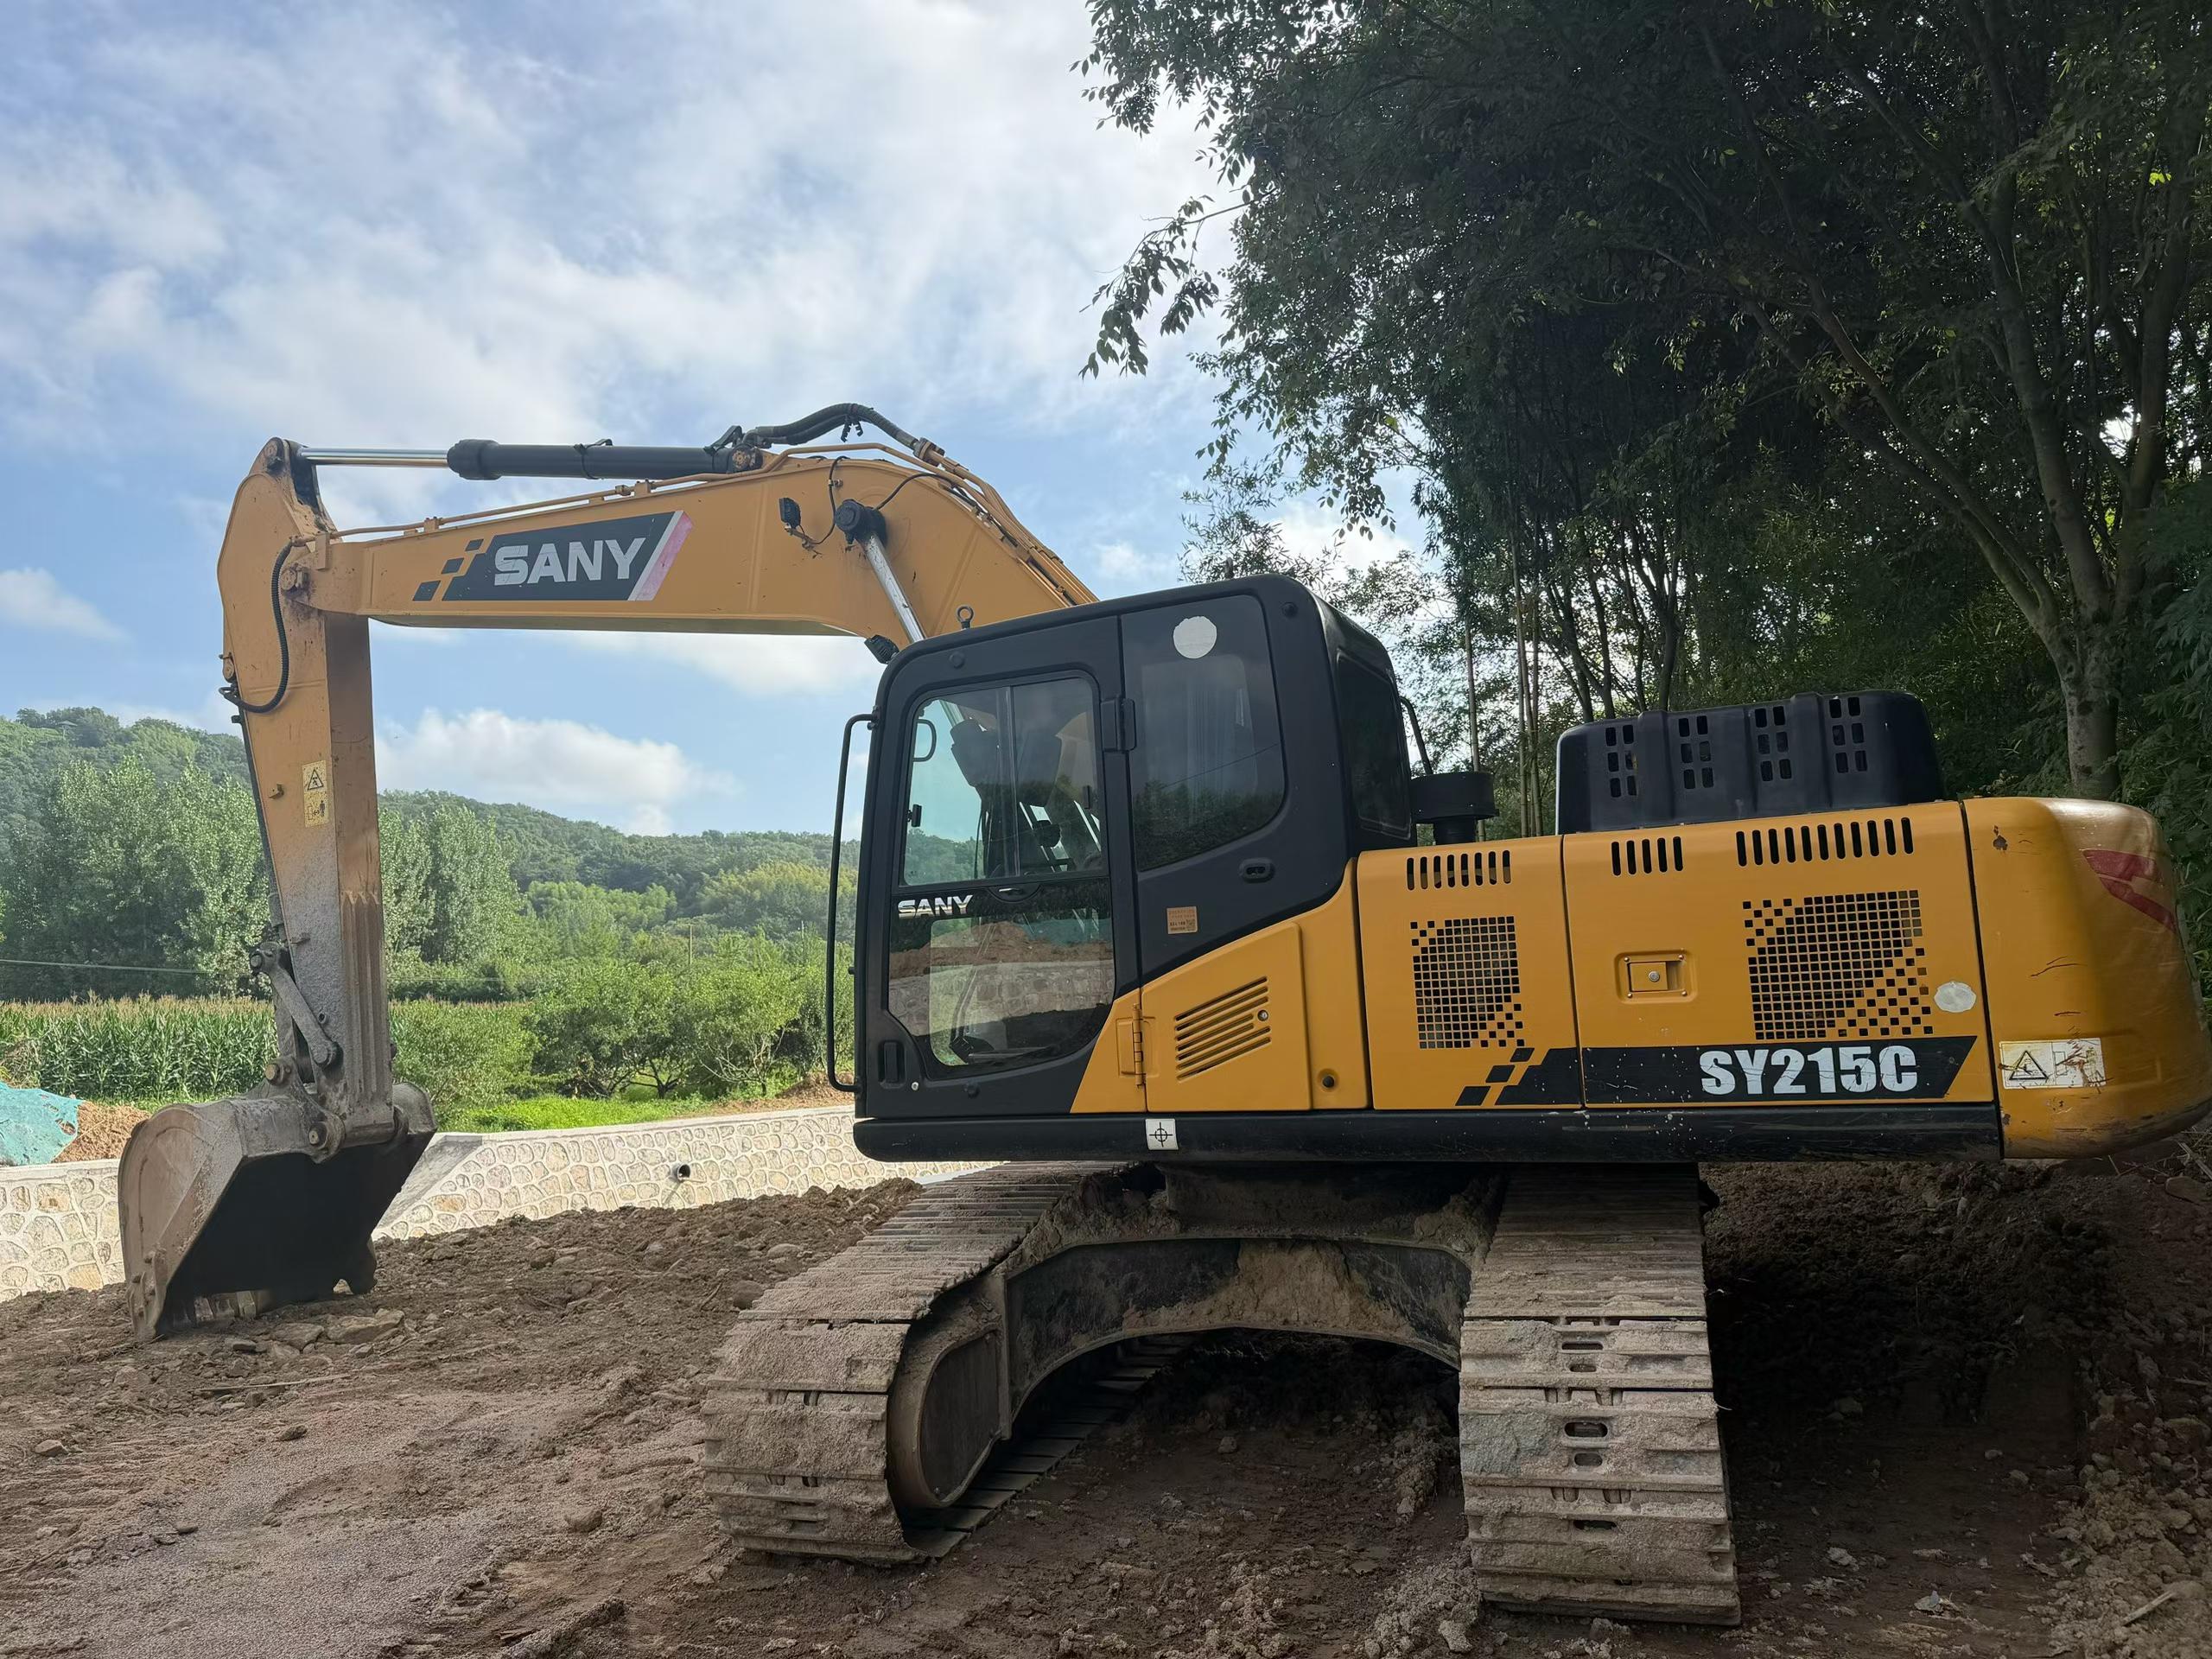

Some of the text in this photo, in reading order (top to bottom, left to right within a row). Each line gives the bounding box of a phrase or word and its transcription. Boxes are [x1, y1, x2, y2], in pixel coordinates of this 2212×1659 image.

[494, 537, 646, 586] SANY
[898, 895, 973, 918] SANY
[1699, 1046, 1917, 1095] SY215C
